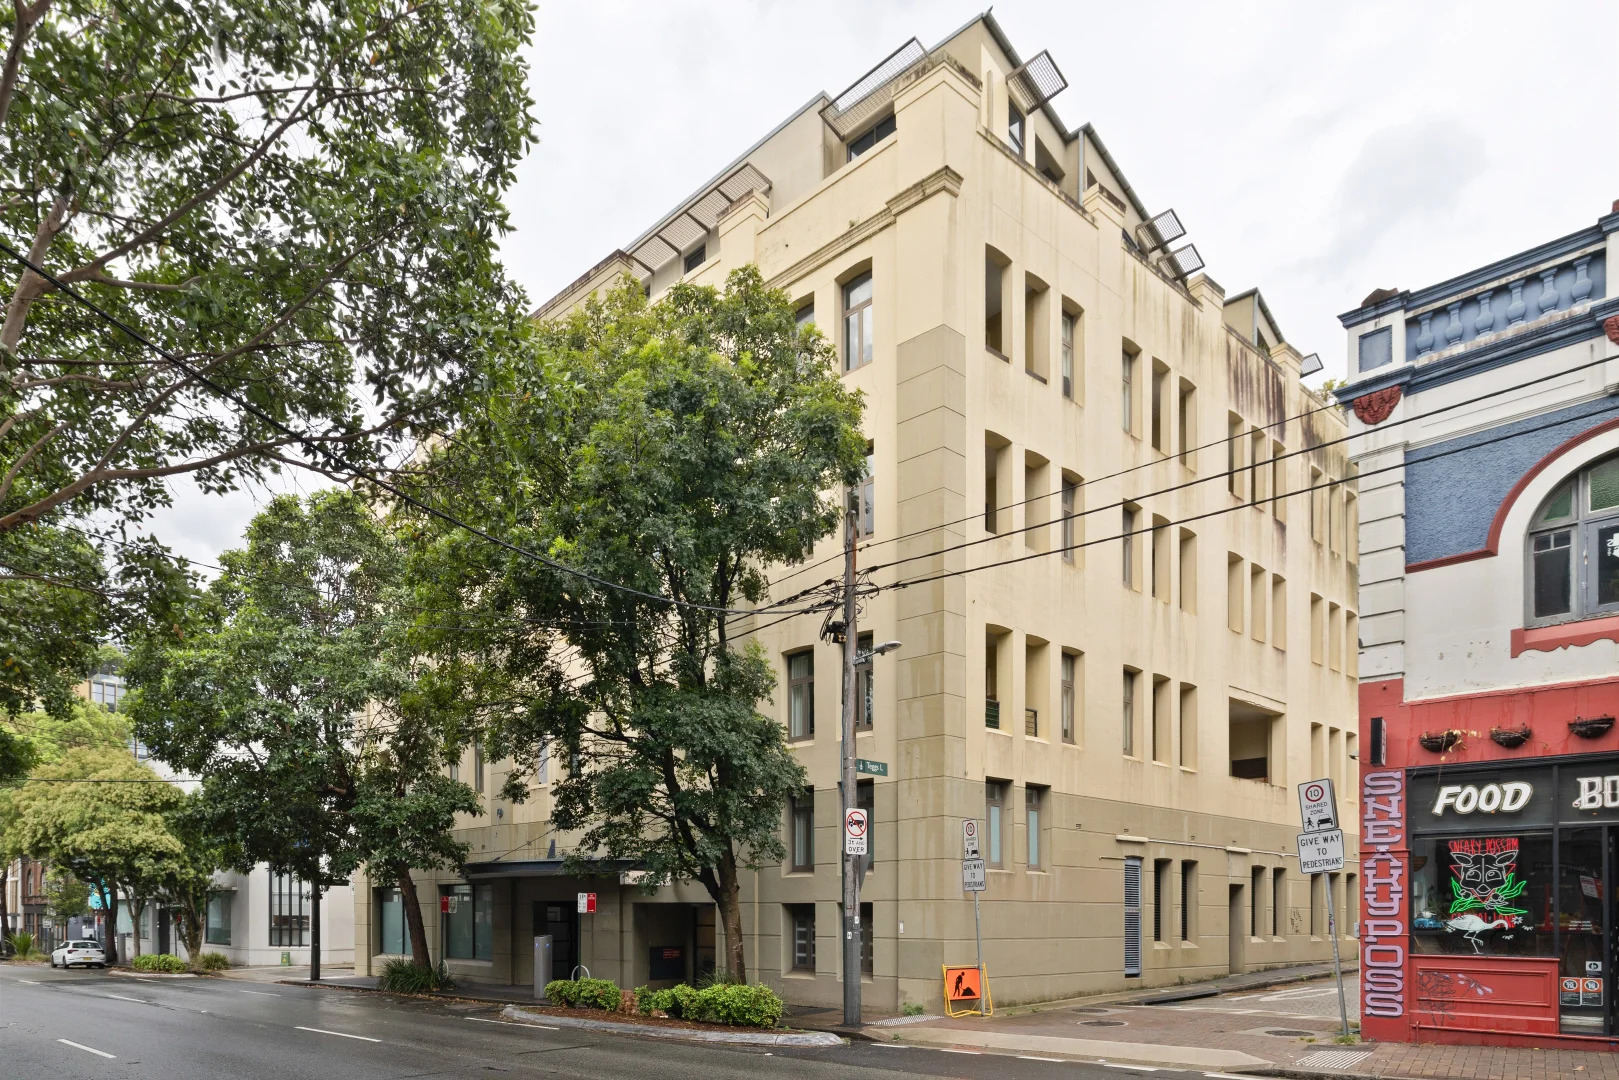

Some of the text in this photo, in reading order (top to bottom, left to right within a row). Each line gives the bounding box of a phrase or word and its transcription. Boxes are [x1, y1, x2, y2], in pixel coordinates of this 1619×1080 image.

[1309, 788, 1319, 798] 10
[1431, 781, 1533, 816] FOOD
[1305, 801, 1328, 810] SHARED
[1300, 834, 1340, 847] GIVE WAY
[1317, 847, 1328, 856] TO
[1448, 839, 1482, 855] SNEAKY
[1302, 857, 1343, 869] PEDESTRIANS
[1363, 771, 1404, 1017] SNEAKY POSS
